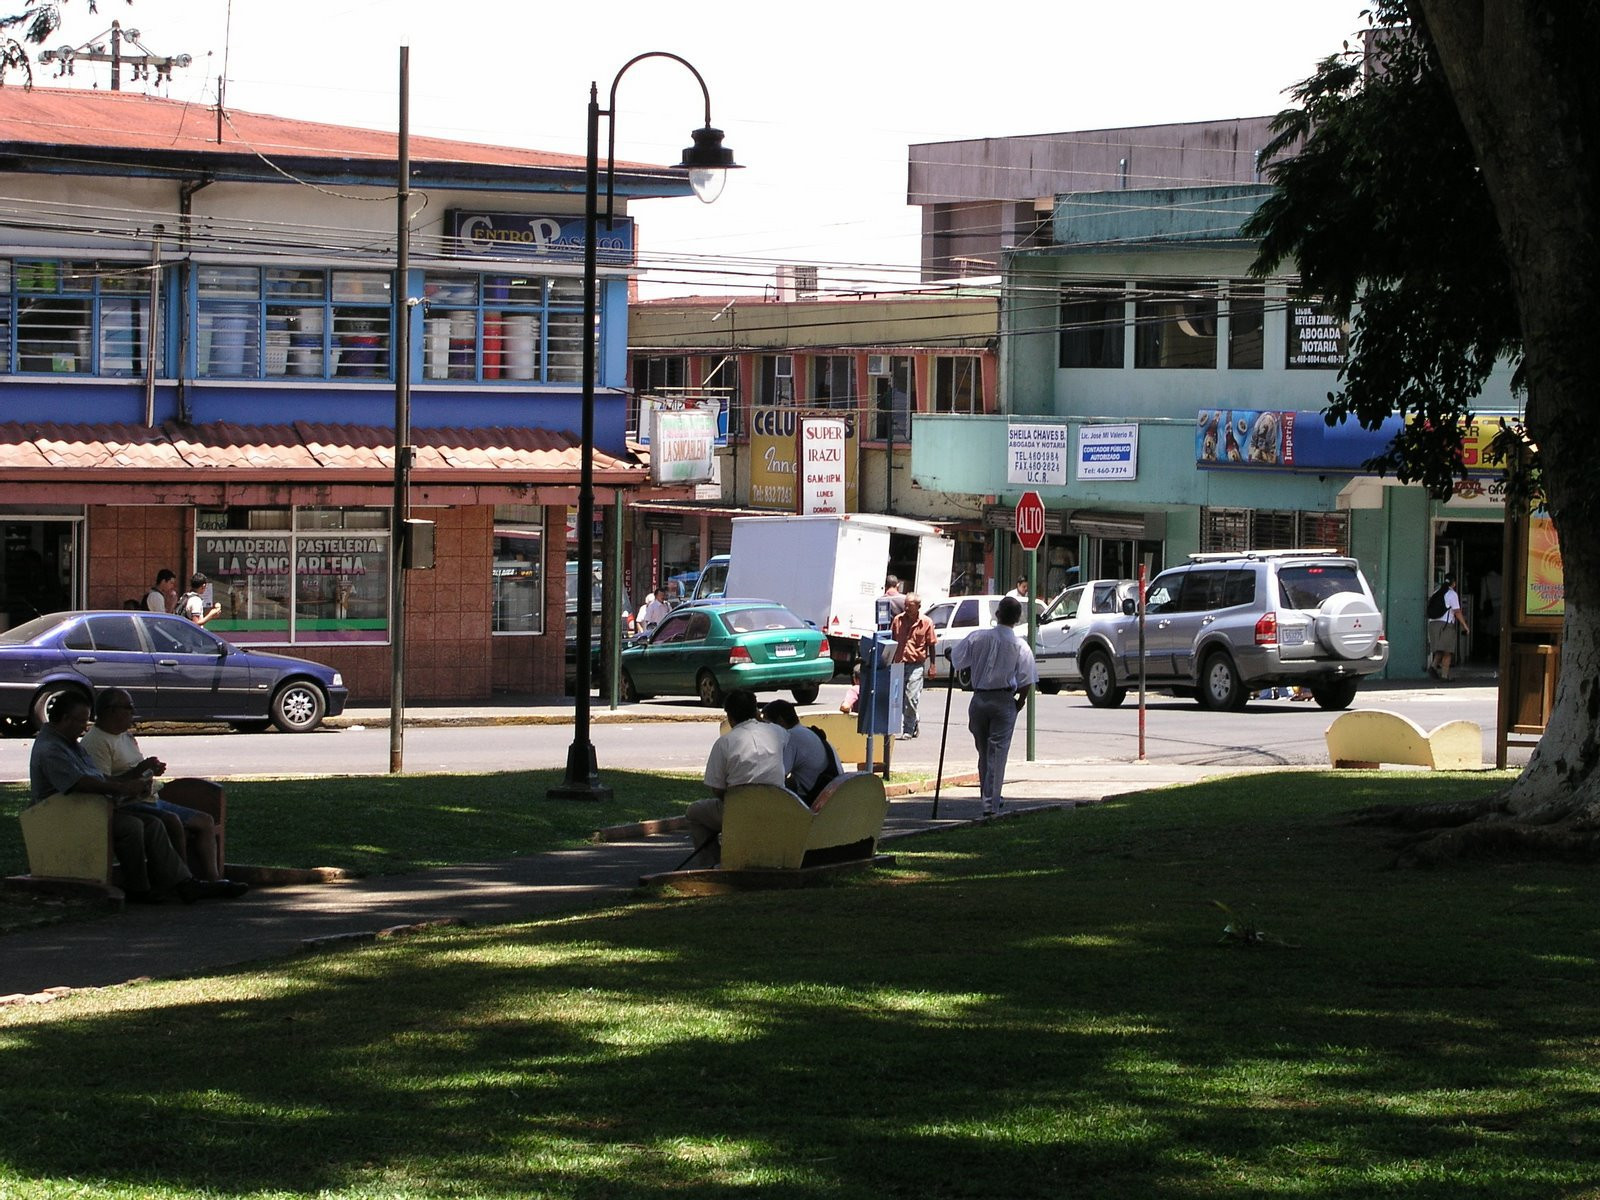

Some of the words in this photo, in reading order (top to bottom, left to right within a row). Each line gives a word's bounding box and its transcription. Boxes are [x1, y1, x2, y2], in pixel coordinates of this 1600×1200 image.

[1299, 328, 1341, 340] ABOGADA
[1301, 340, 1338, 353] NOTARIA
[806, 427, 842, 440] SUPER
[1009, 429, 1031, 440] SHEILA
[1033, 429, 1059, 440] CHAVES
[1284, 415, 1293, 461] Imperial
[808, 448, 841, 462] IRAZU
[1083, 445, 1110, 453] CONTADOR
[1090, 453, 1120, 461] AUTORIZADO
[816, 490, 834, 498] LUNES
[1018, 506, 1042, 534] ALTO
[206, 539, 287, 553] PANADERIA
[297, 539, 378, 553] PASTELERIA
[218, 556, 241, 576] LA
